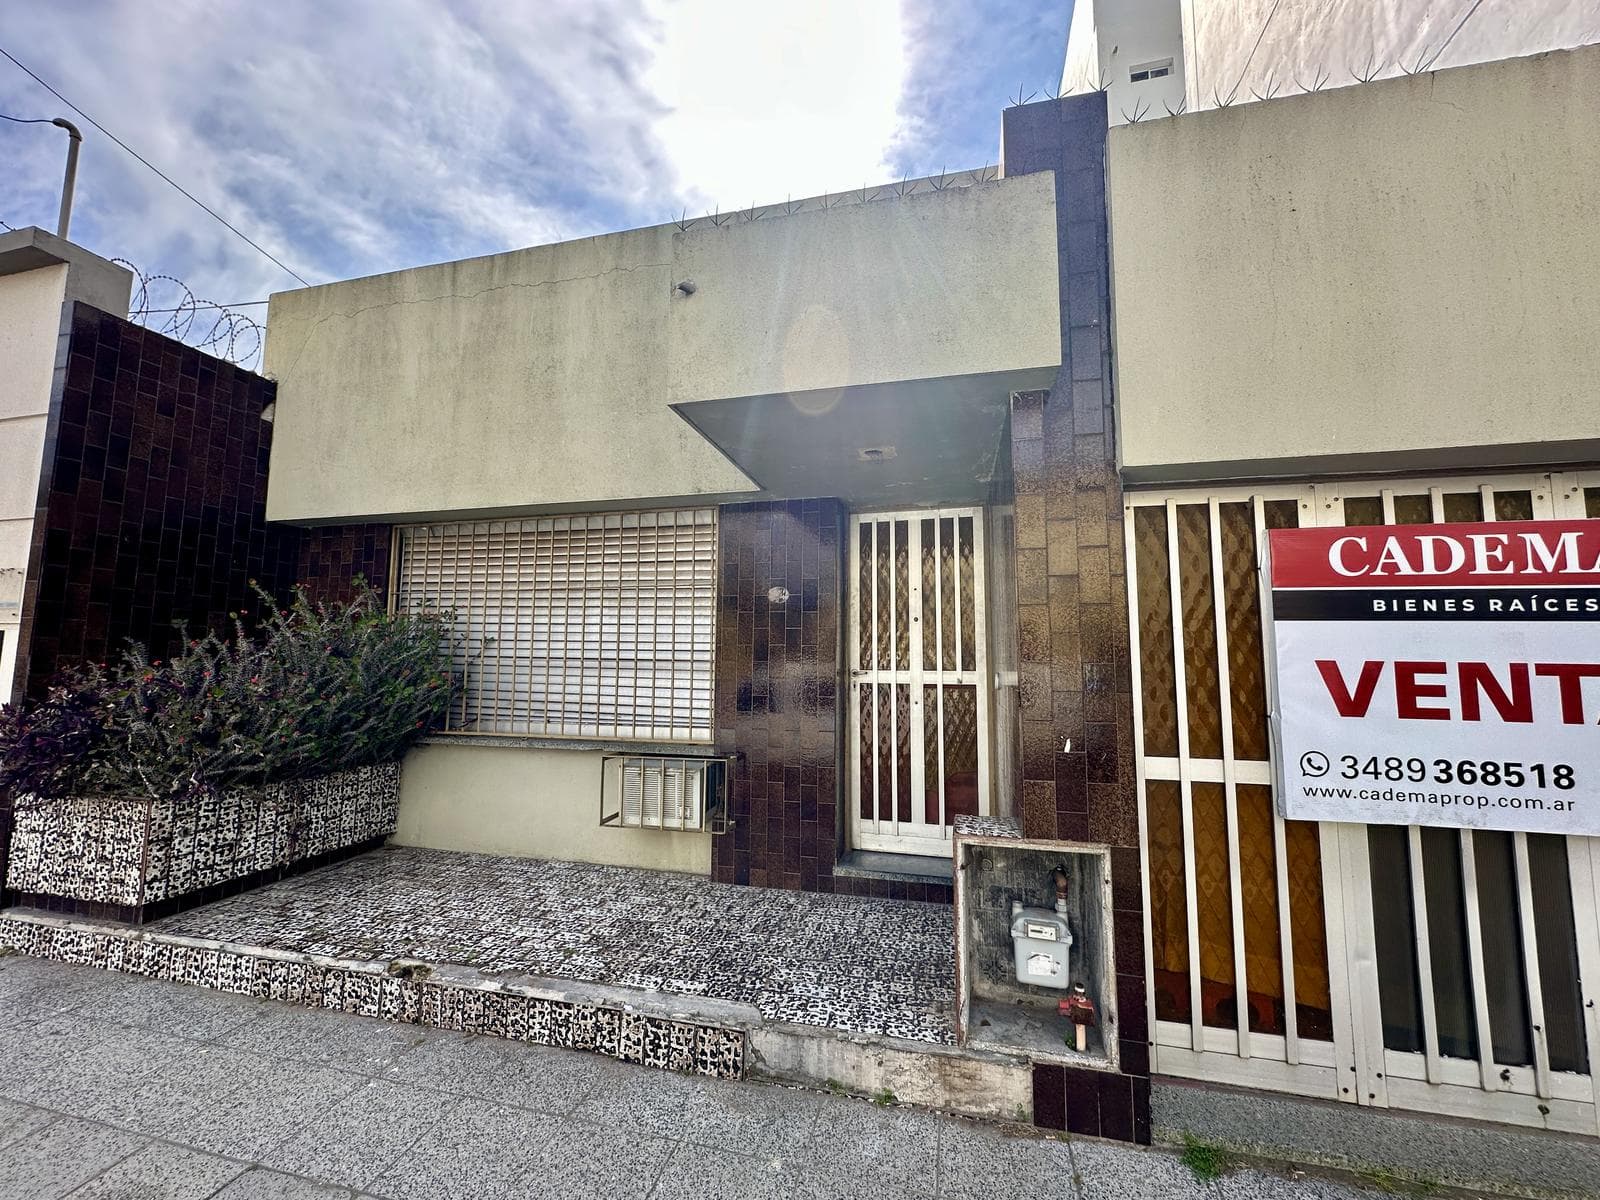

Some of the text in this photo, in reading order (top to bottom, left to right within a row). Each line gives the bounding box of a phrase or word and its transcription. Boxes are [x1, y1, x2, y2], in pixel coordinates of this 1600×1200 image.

[1328, 532, 1600, 577] CADEM
[1373, 594, 1599, 612] BIENES RAÍCES
[1314, 660, 1600, 726] VENT
[1303, 786, 1576, 812] www.cademaprop.com.ar
